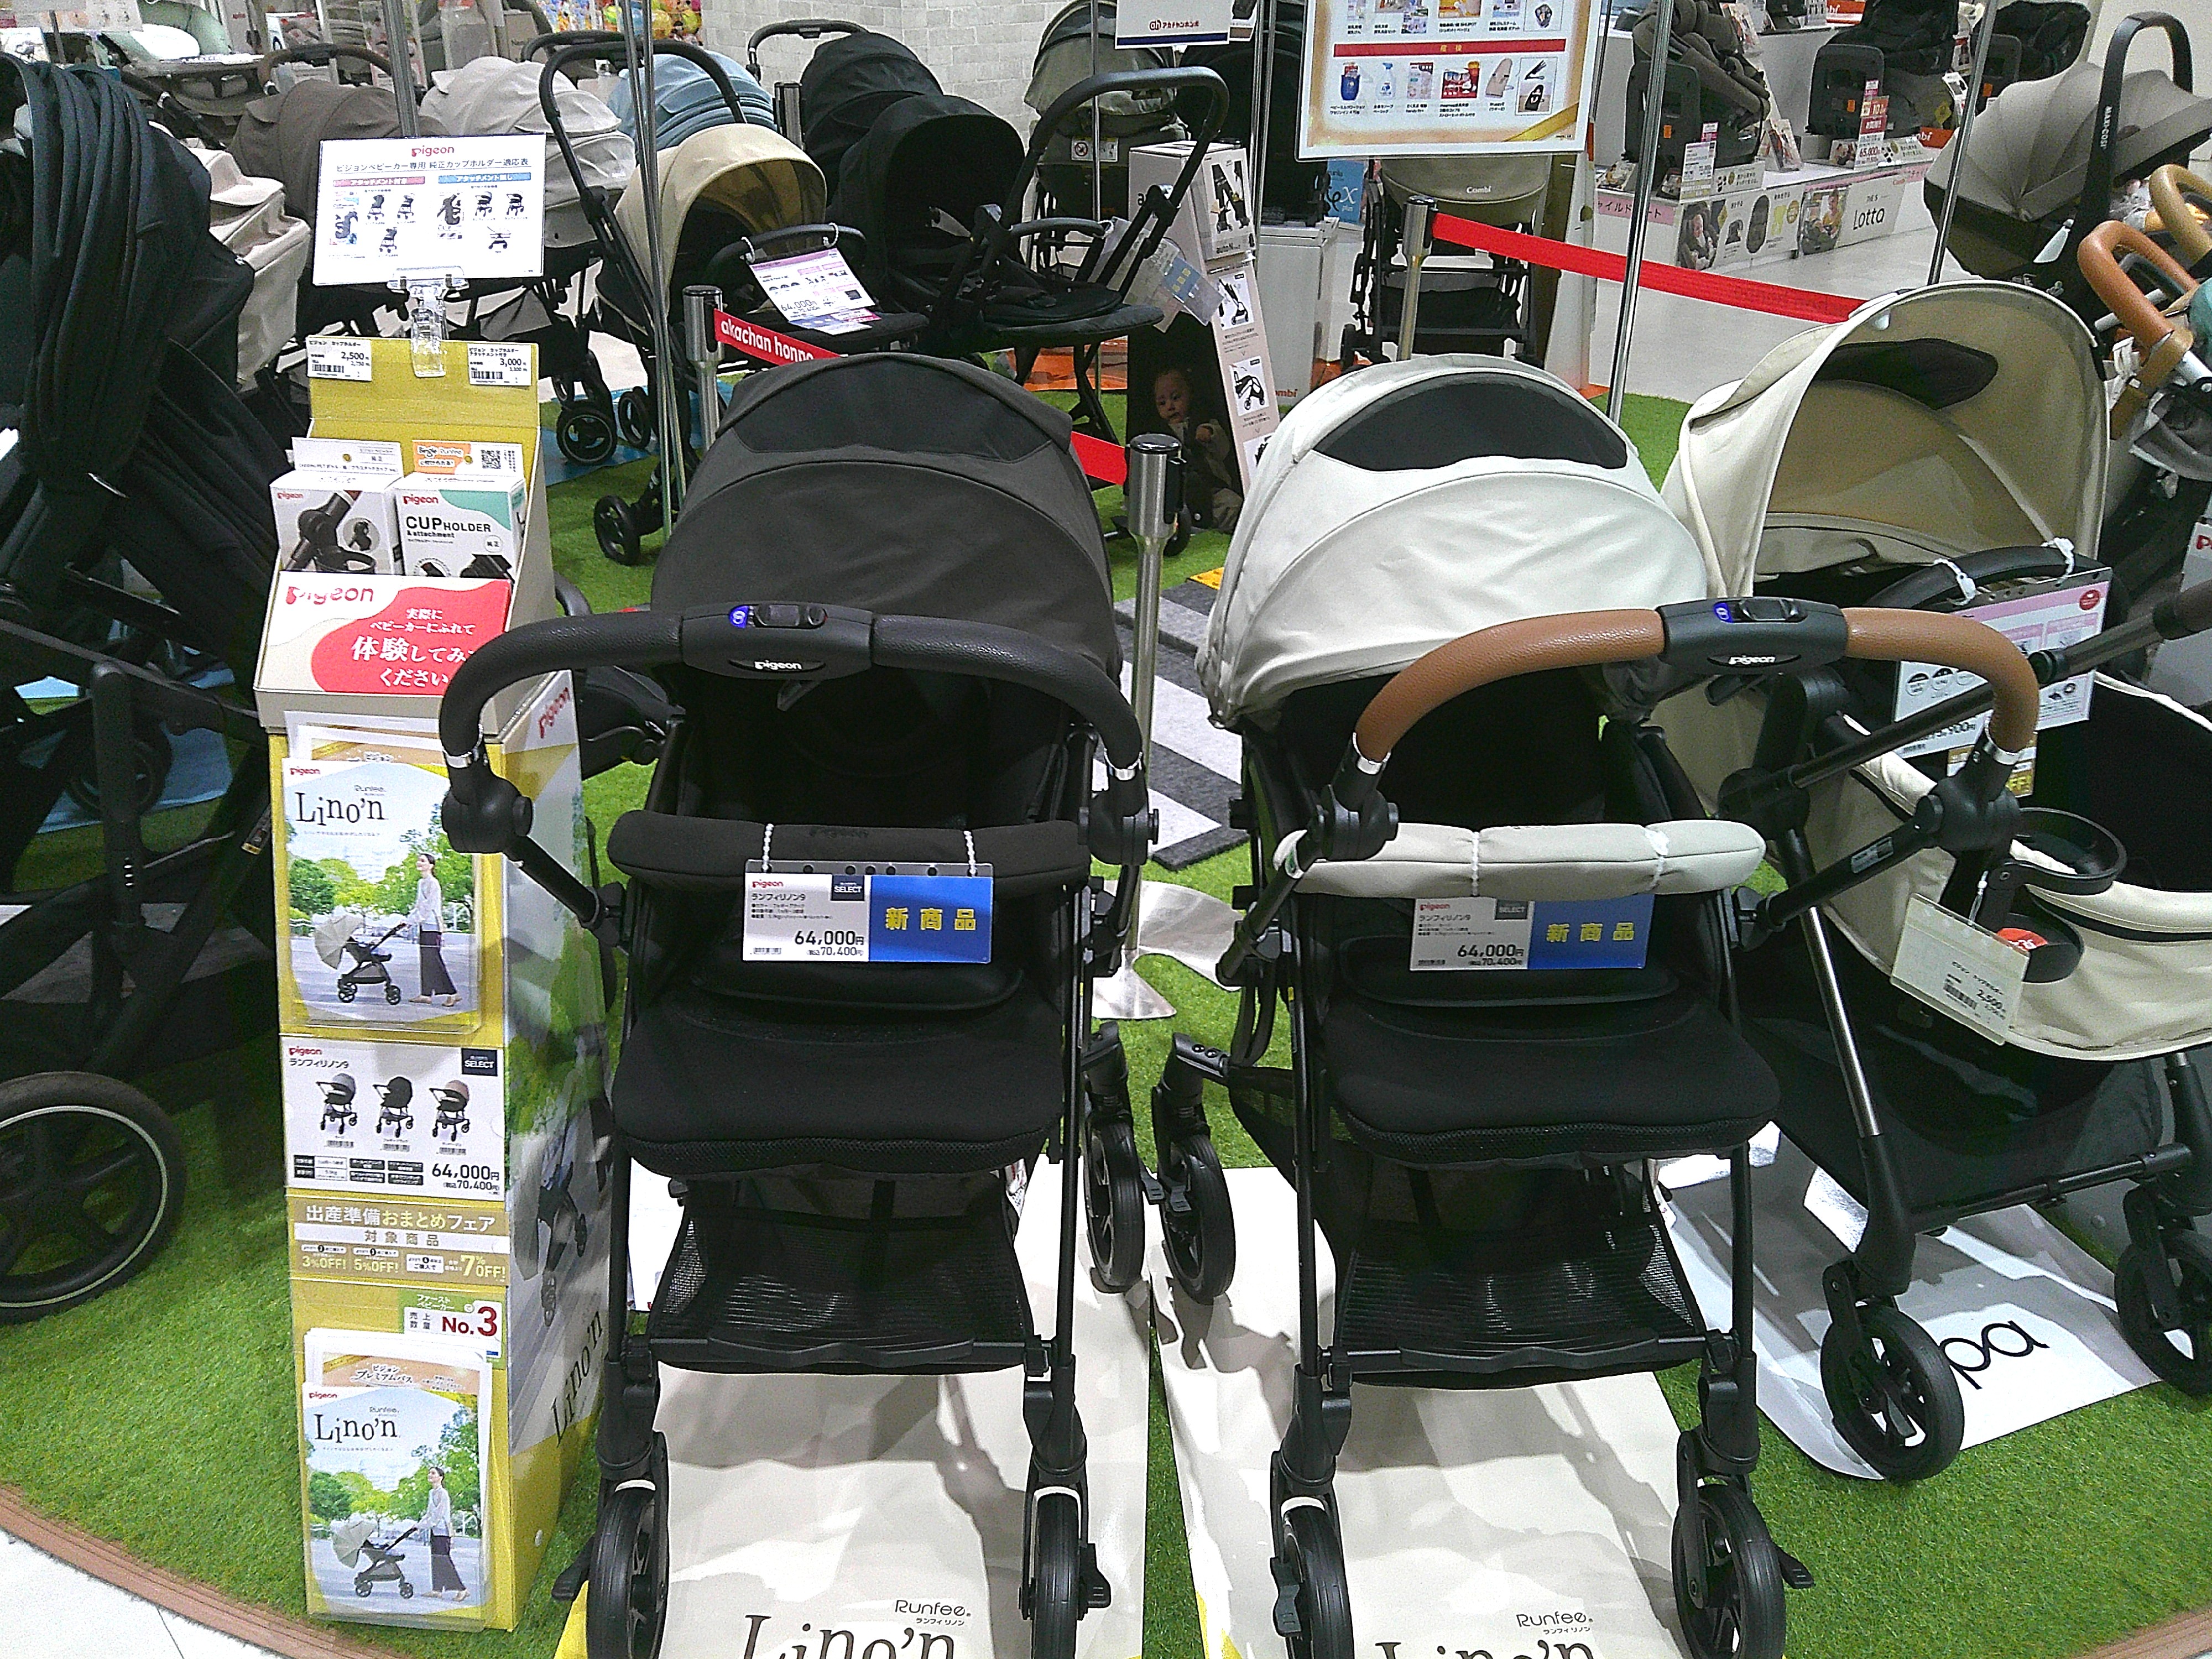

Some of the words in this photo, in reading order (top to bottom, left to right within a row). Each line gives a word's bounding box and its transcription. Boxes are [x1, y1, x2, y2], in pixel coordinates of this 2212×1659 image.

[411, 145, 455, 157] pigeon
[337, 161, 426, 173] ピジョンベビーカー専用
[429, 158, 529, 170] 純正カップホルダー適応表
[1467, 185, 1491, 194] Combi
[721, 318, 772, 354] akachan
[277, 491, 304, 501] pigeon
[403, 494, 439, 505] pigeon
[406, 516, 442, 530] CUP
[444, 522, 492, 533] HOLDER
[414, 530, 455, 539] attachment
[285, 585, 374, 606] pigeon
[406, 607, 443, 621] 実際に
[369, 620, 476, 635] ベビーカーにふれて
[754, 660, 802, 671] pigeon
[1729, 654, 1776, 665] pigeon
[379, 667, 450, 687] ください
[290, 766, 321, 776] pigeon
[295, 792, 386, 827] Lino'n
[752, 879, 784, 889] pigeon
[1420, 902, 1451, 911] pigeon
[885, 907, 977, 931] 新商品
[795, 930, 864, 946] 64,000円
[1546, 922, 1635, 942] 新商品
[1457, 944, 1524, 958] 64,000円
[288, 1046, 322, 1056] pigeon
[464, 1059, 495, 1069] SELECT
[431, 1163, 500, 1182] 64,000円
[306, 1204, 496, 1233] 出産準備おまとめフェア
[364, 1229, 440, 1247] 対象商品
[416, 1294, 451, 1304] ファースト
[416, 1302, 455, 1311] ベビーカー
[409, 1312, 431, 1322] 売上
[373, 1365, 399, 1373] ピジョン
[357, 1370, 413, 1383] プレミアムパス
[309, 1392, 338, 1400] pigeon
[314, 1413, 398, 1444] Lino'n
[894, 1599, 967, 1616] Runfee
[1516, 1611, 1587, 1627] Runfee
